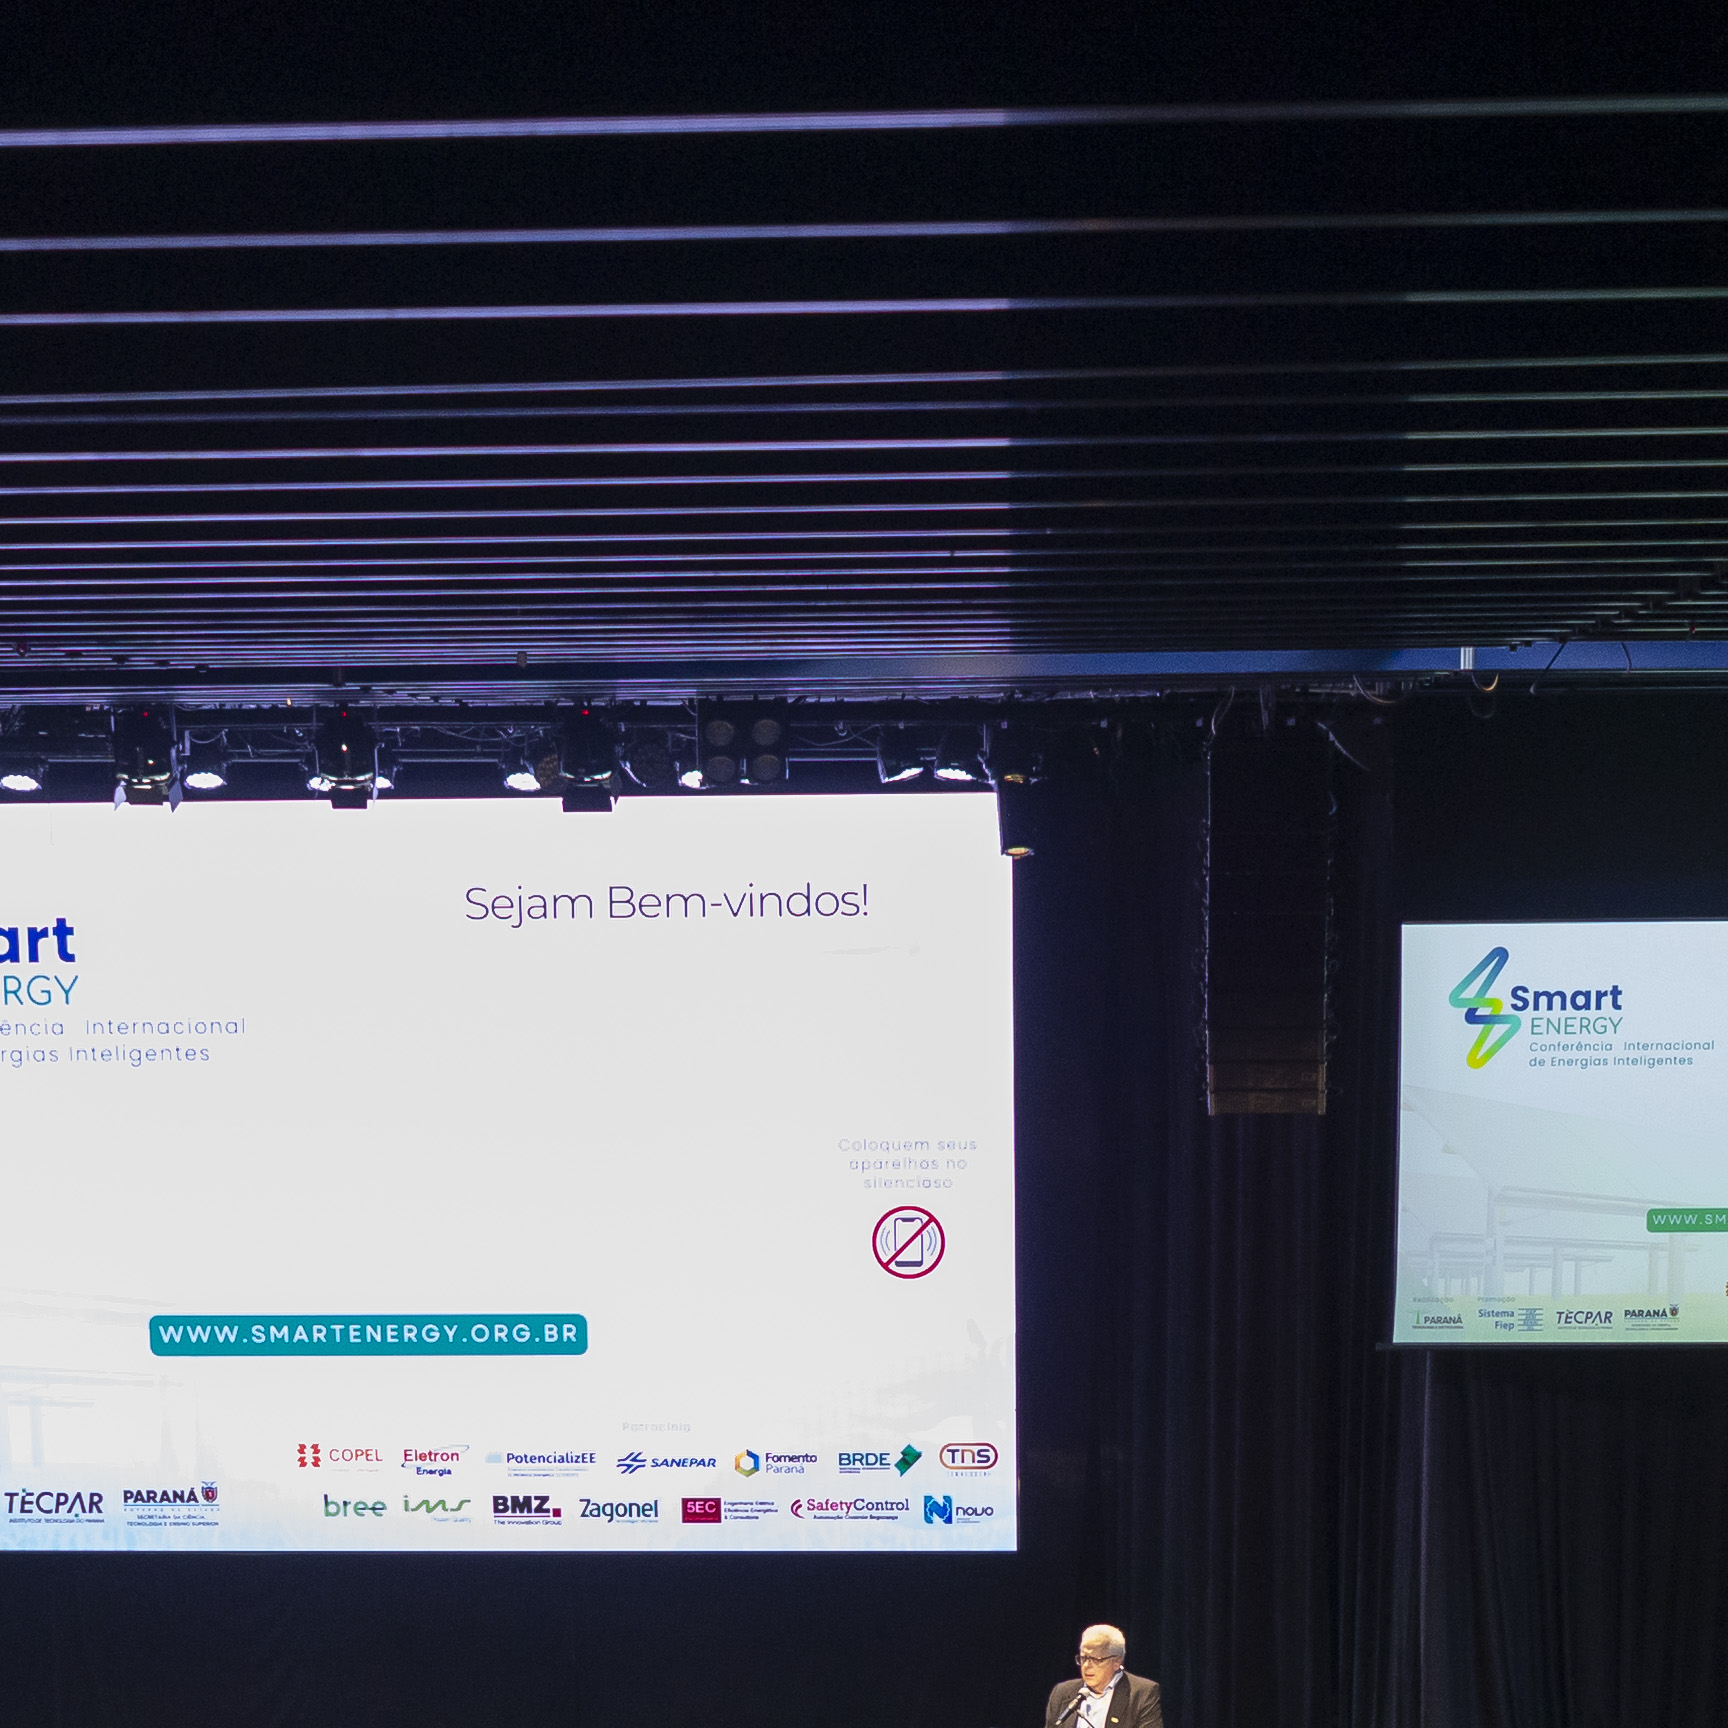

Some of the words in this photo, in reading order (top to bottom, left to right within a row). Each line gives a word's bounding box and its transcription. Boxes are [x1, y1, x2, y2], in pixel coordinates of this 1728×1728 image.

[465, 886, 594, 928] Sejam
[608, 882, 869, 919] Bem-vindos!
[1510, 985, 1623, 1011] Smart
[85, 1017, 246, 1036] Internacional
[1530, 1016, 1623, 1035] ENERGY
[1529, 1040, 1613, 1052] Conferência
[1623, 1039, 1715, 1051] Internacional
[69, 1044, 211, 1067] Inteligentes
[1529, 1056, 1546, 1067] de
[1550, 1055, 1609, 1070] Energias
[1613, 1054, 1694, 1069] Inteligentes
[838, 1138, 930, 1153] Coloquem
[937, 1139, 977, 1151] seus
[849, 1157, 939, 1174] aparelhos
[946, 1158, 968, 1170] no
[864, 1176, 953, 1189] silencioso
[1423, 1313, 1463, 1325] PARANÁ
[1478, 1308, 1515, 1318] Sistema
[1556, 1308, 1614, 1325] TECPAR
[1623, 1308, 1668, 1318] PARANÁ
[158, 1323, 578, 1344] WWW.SMARTENERGY.ORG.BR
[1494, 1320, 1515, 1332] Fiep
[329, 1449, 384, 1462] COPEL
[403, 1449, 460, 1462] Eletron
[506, 1451, 597, 1464] PotencializEE
[650, 1458, 717, 1468] SANEPAR
[765, 1452, 818, 1464] Fomento
[838, 1452, 891, 1466] BRDE
[416, 1467, 452, 1477] Energia
[765, 1462, 805, 1475] Paraná
[3, 1489, 104, 1515] TECPAR
[123, 1488, 199, 1504] PARANÁ
[323, 1494, 387, 1517] bree
[403, 1494, 472, 1514] ims
[578, 1498, 659, 1524] Zagonel
[806, 1498, 910, 1514] SafetyControl
